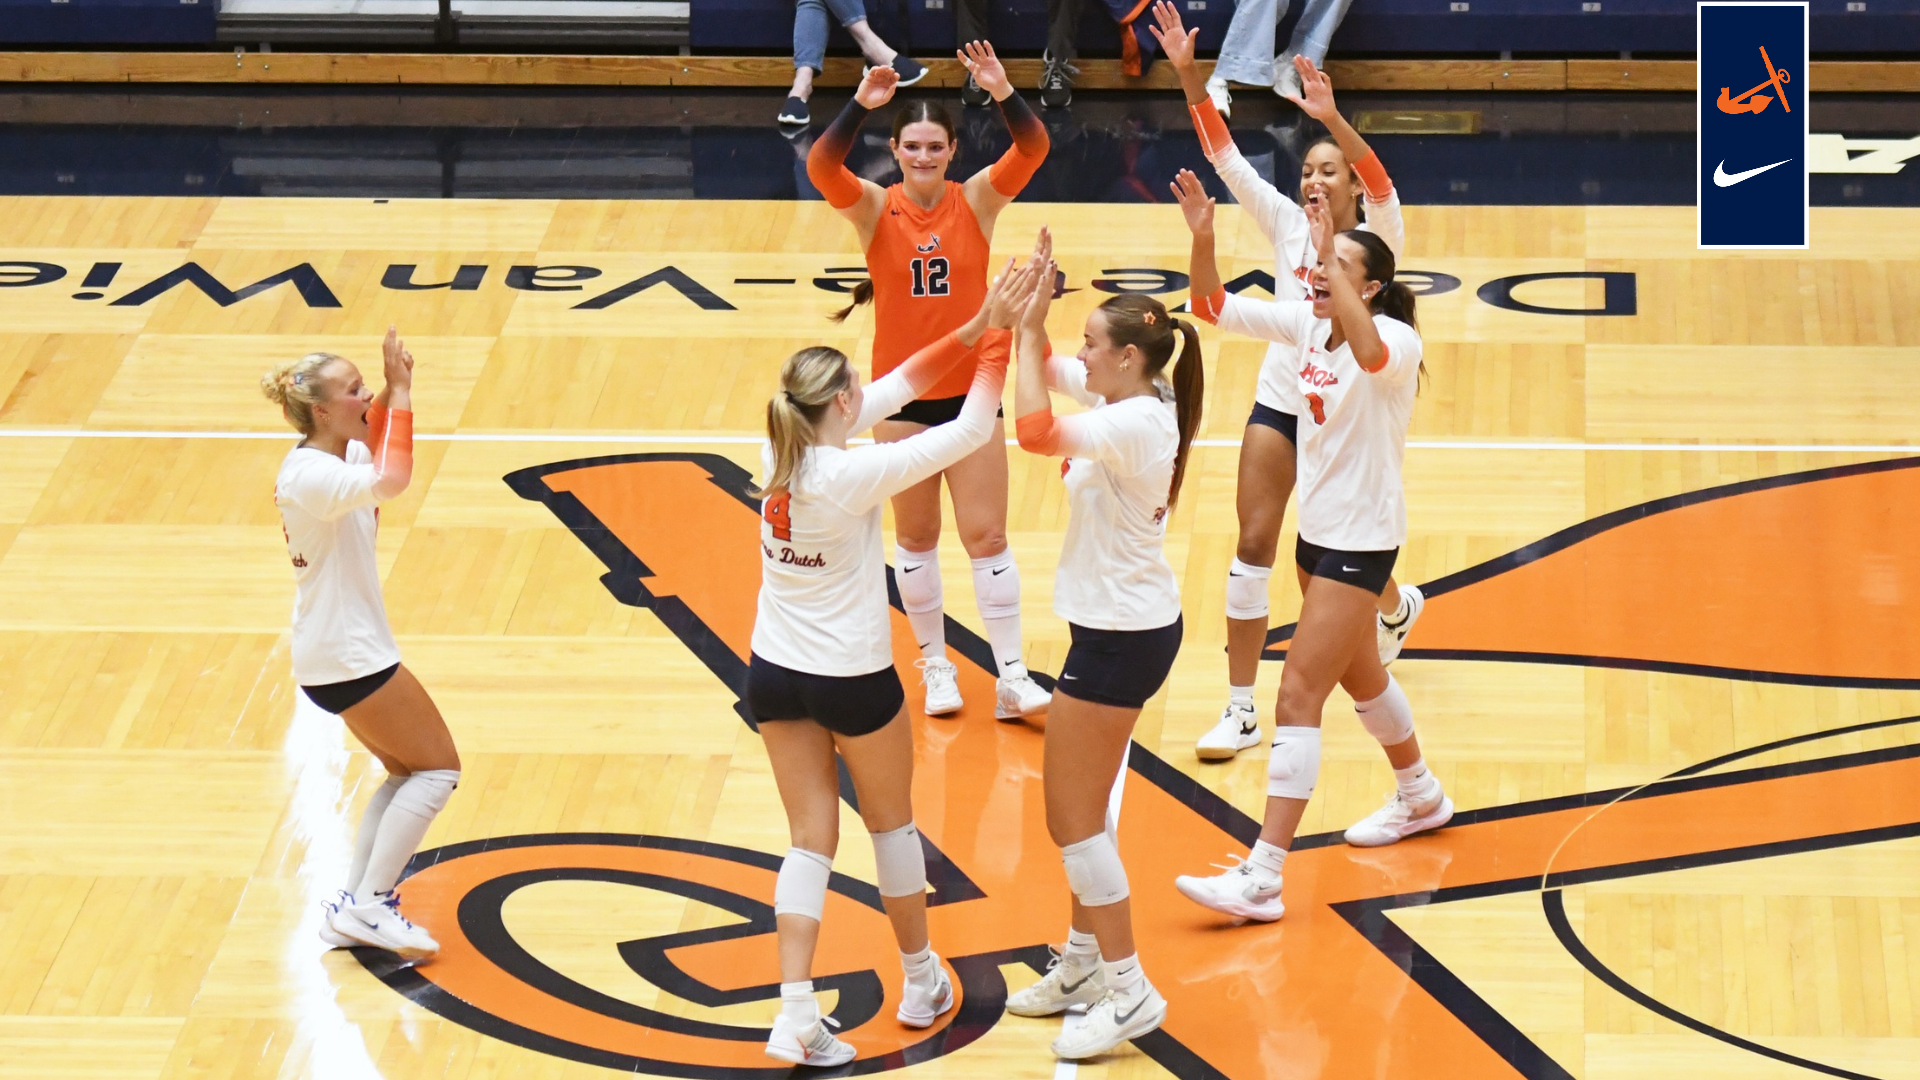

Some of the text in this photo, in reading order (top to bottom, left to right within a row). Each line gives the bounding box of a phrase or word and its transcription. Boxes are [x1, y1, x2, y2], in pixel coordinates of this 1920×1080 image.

[910, 256, 950, 297] 12
[764, 487, 792, 542] 4
[779, 547, 826, 567] Dutch
